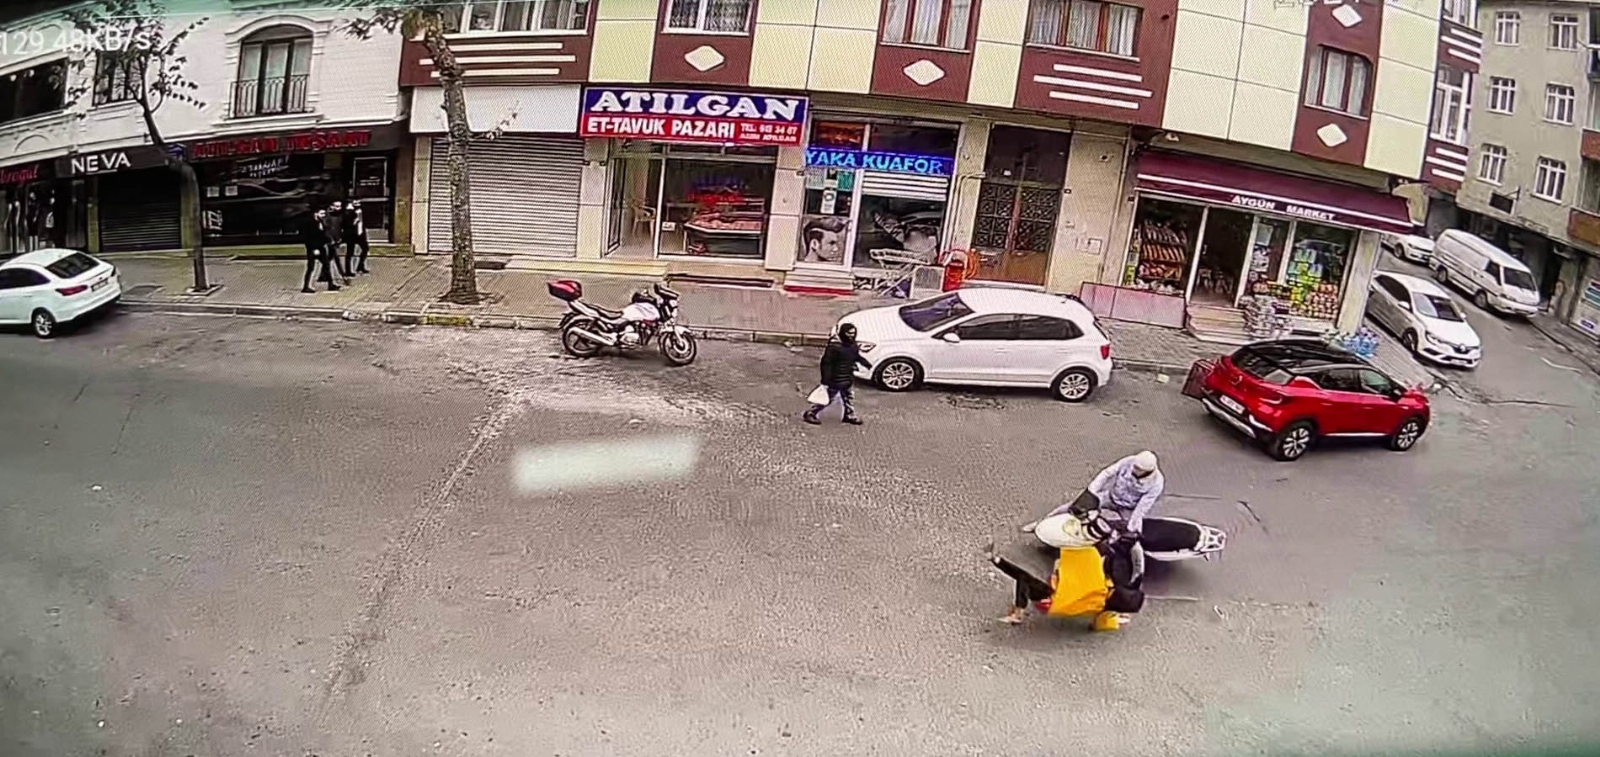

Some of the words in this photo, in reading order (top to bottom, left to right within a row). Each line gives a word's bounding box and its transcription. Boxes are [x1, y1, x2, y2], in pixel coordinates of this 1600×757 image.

[591, 91, 799, 121] ATILGAN
[587, 117, 666, 135] ET-TAVUK
[671, 119, 735, 139] PAZARI
[71, 152, 131, 175] NEVA
[806, 151, 856, 167] YAKA
[1286, 205, 1335, 220] MARKET
